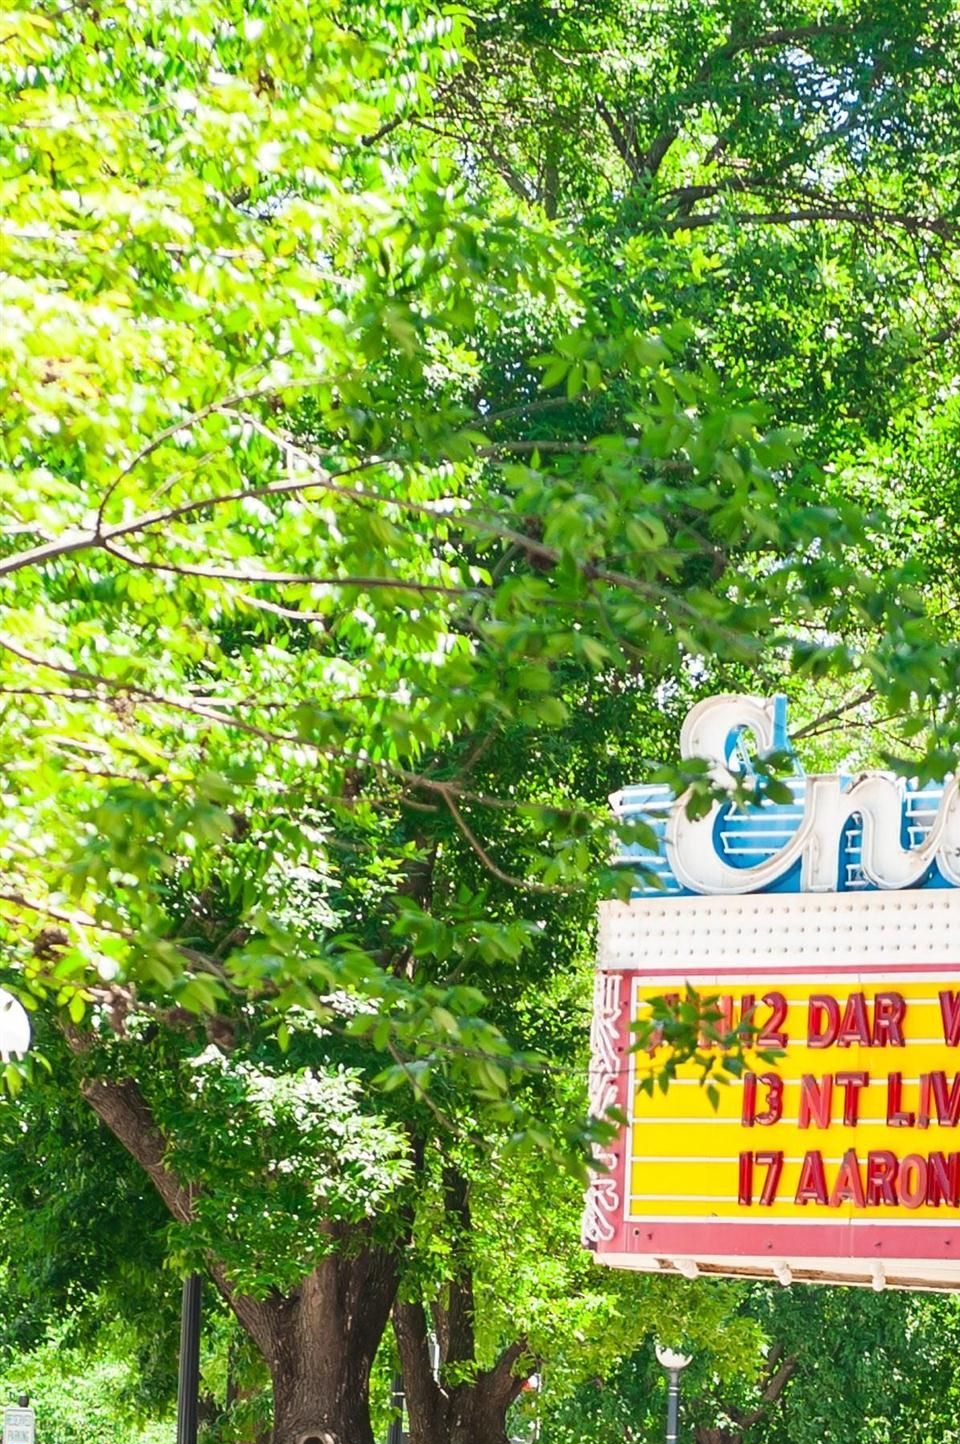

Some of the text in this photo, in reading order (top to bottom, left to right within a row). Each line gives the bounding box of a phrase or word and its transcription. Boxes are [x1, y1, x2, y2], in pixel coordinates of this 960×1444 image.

[807, 990, 906, 1049] DAR
[741, 1072, 785, 1128] 13
[798, 1071, 869, 1130] NT
[738, 1150, 785, 1207] 17
